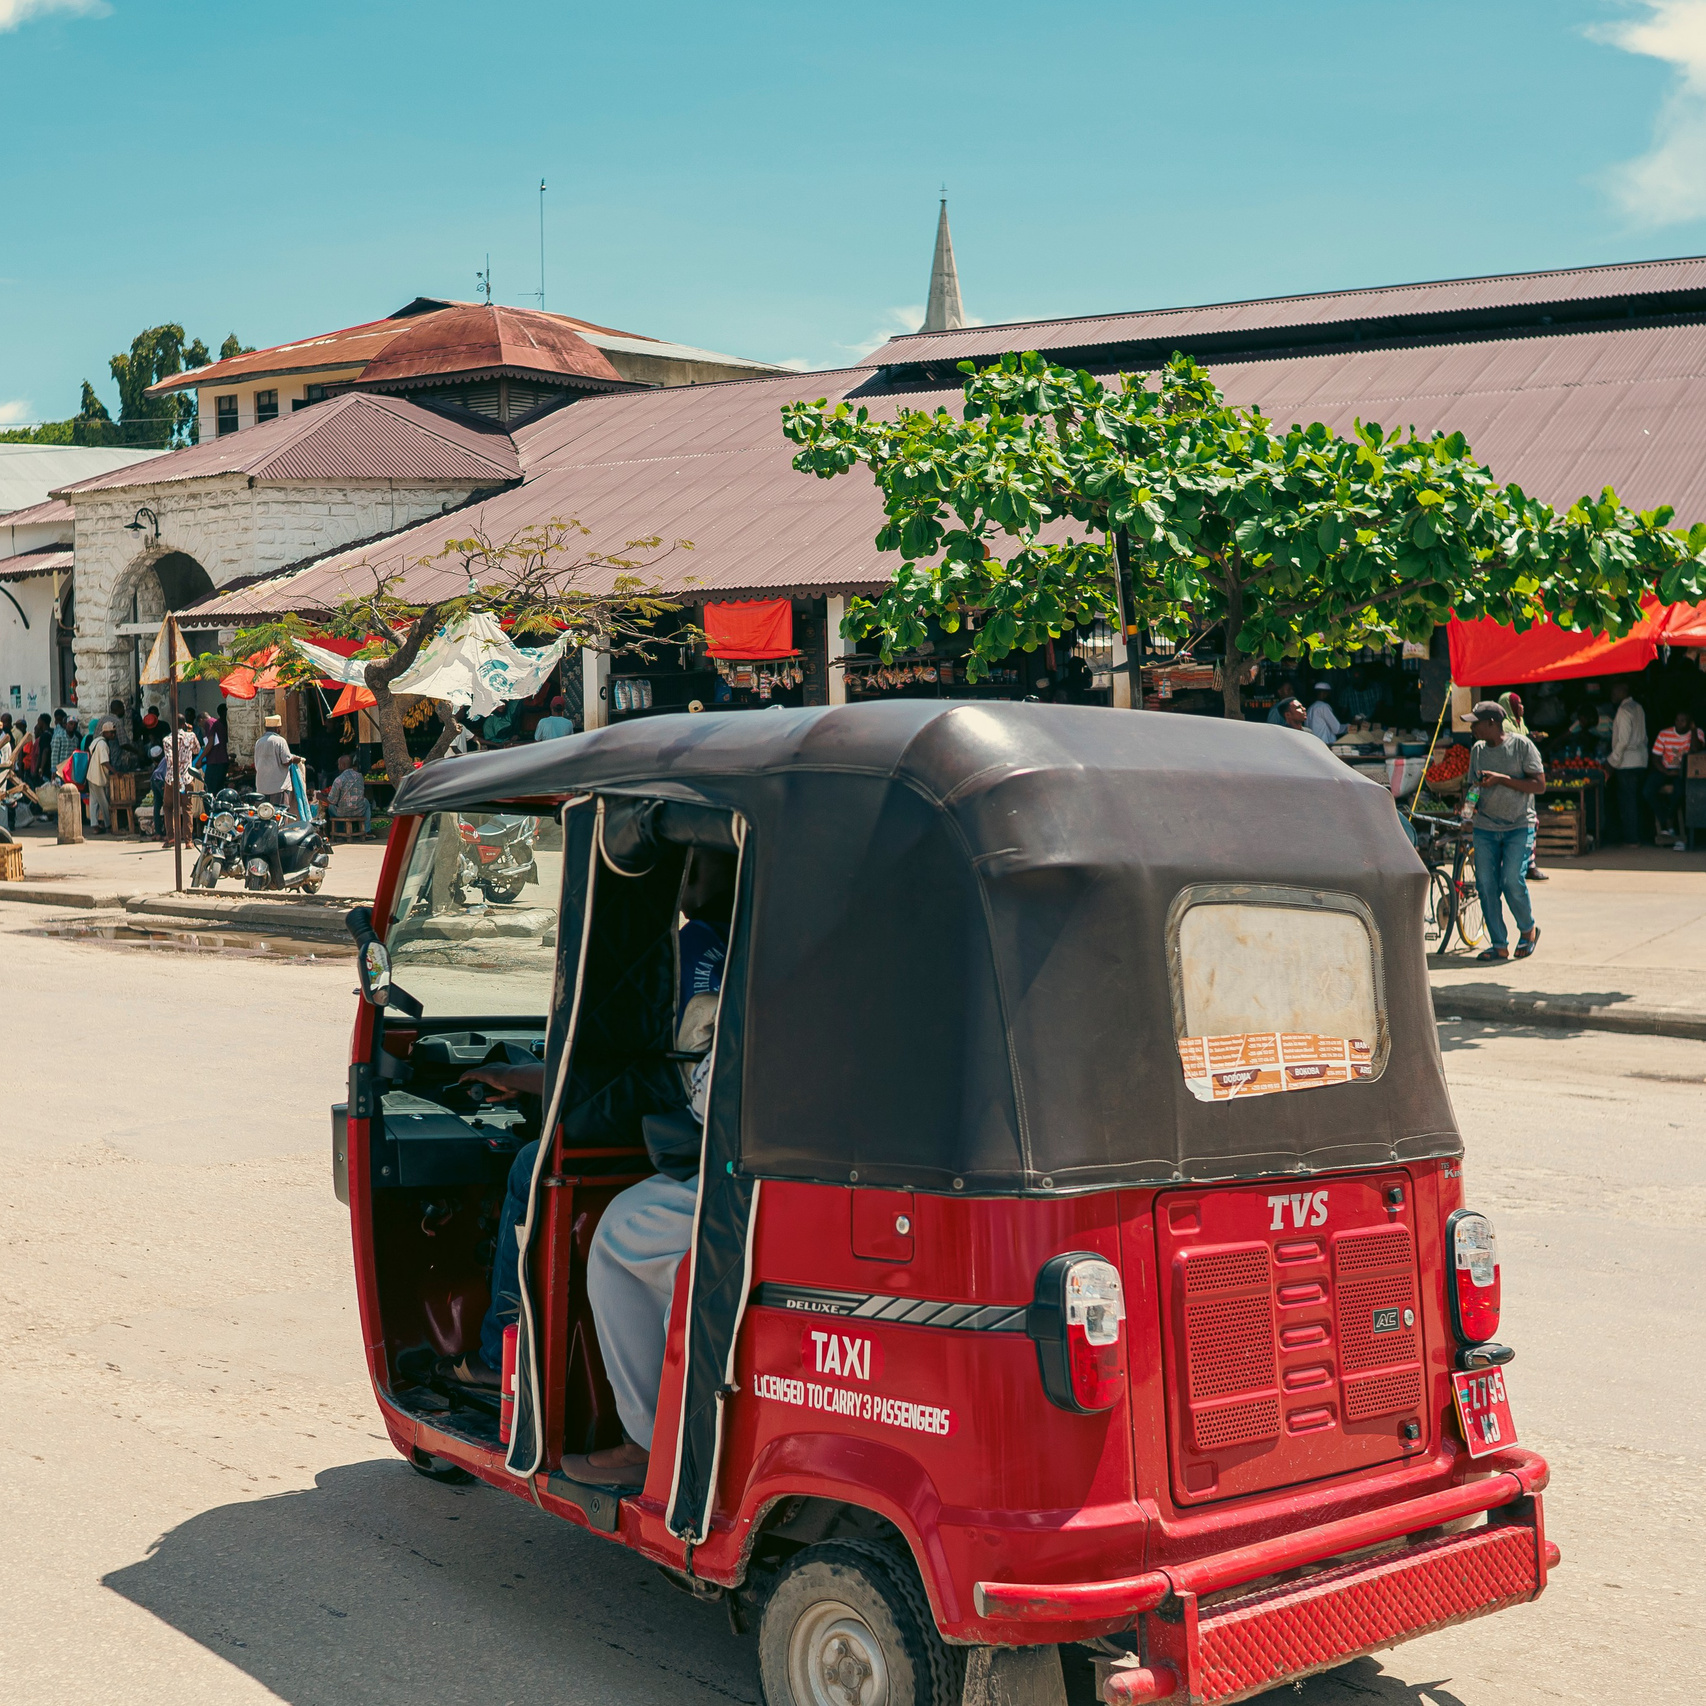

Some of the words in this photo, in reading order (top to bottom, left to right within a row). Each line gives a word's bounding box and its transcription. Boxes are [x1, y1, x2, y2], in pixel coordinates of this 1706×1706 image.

[1222, 1072, 1251, 1084] DODOMA
[1267, 1190, 1329, 1231] TVS
[786, 1299, 840, 1315] DELUXE
[1376, 1312, 1397, 1328] AC
[811, 1330, 872, 1381] TAXI
[754, 1374, 805, 1406] LICENSED
[807, 1383, 823, 1409] TO
[823, 1387, 864, 1418] CARRY
[863, 1394, 872, 1420] 3
[873, 1396, 950, 1436] PASSENGERS
